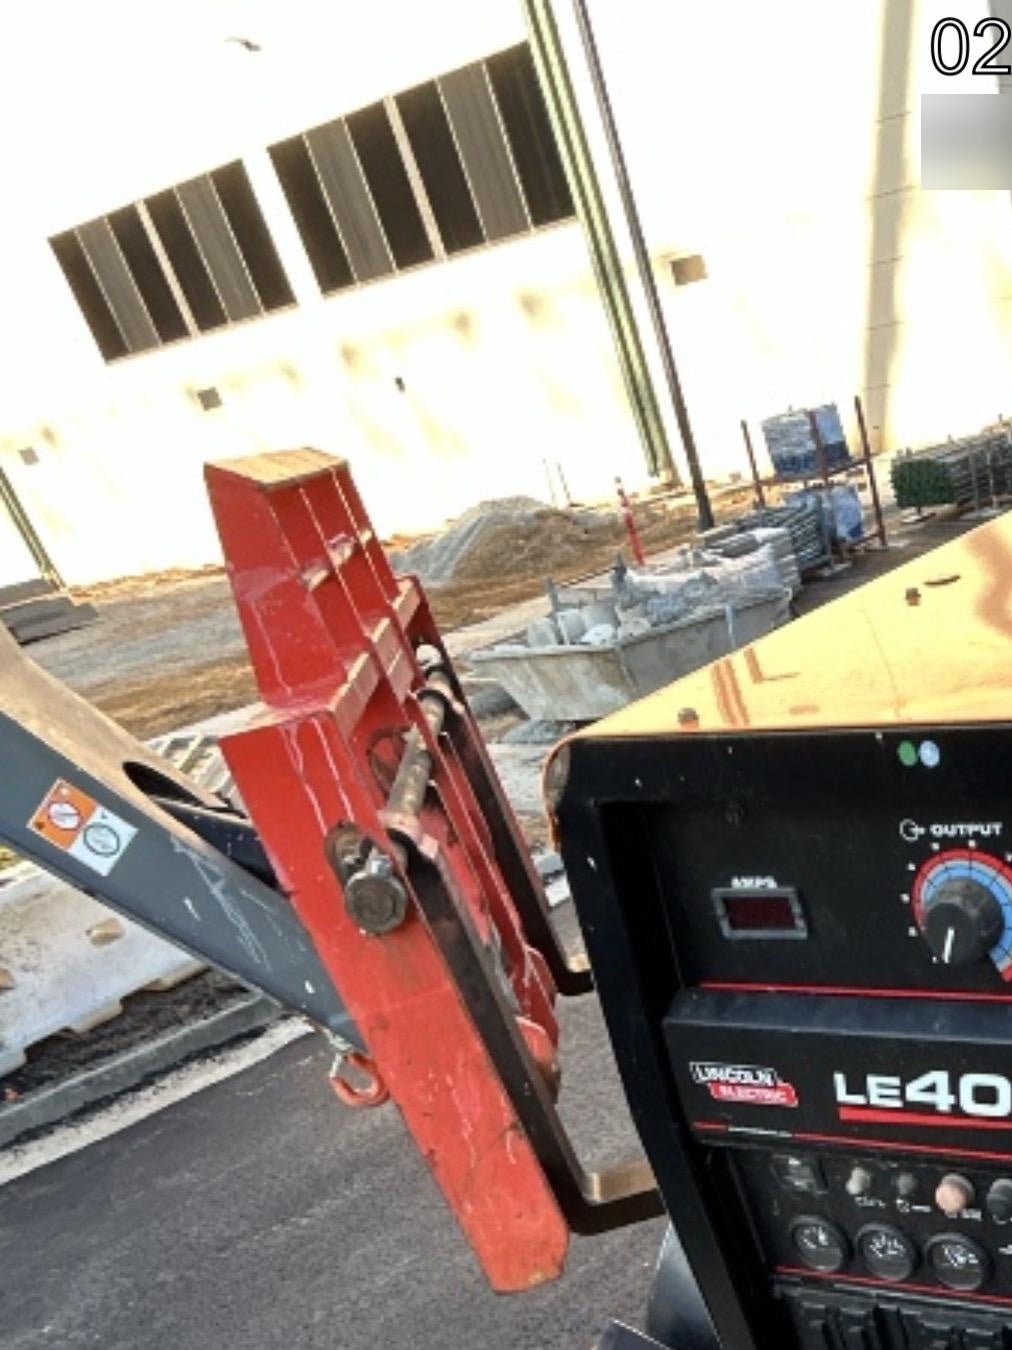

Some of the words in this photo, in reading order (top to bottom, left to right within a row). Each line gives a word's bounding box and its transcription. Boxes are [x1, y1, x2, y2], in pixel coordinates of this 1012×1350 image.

[930, 822, 1002, 837] OUTPUT
[697, 1066, 774, 1086] LINCOLN
[719, 1085, 786, 1104] ELECTRIC
